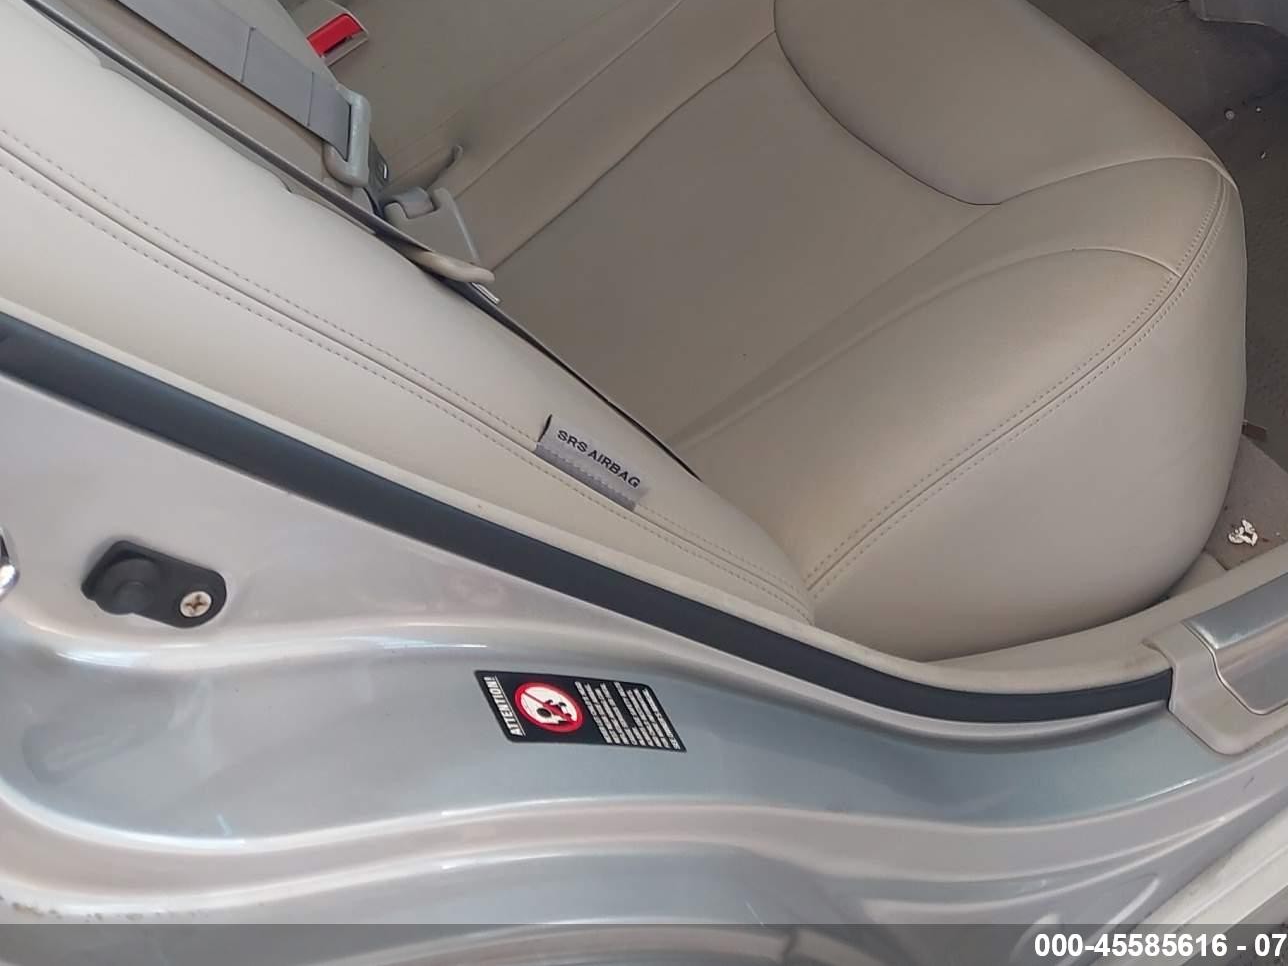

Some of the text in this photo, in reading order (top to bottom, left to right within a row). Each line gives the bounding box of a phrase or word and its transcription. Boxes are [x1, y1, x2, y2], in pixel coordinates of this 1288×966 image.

[557, 430, 641, 488] SRS AIRBAG
[484, 676, 524, 736] ATTENTION!
